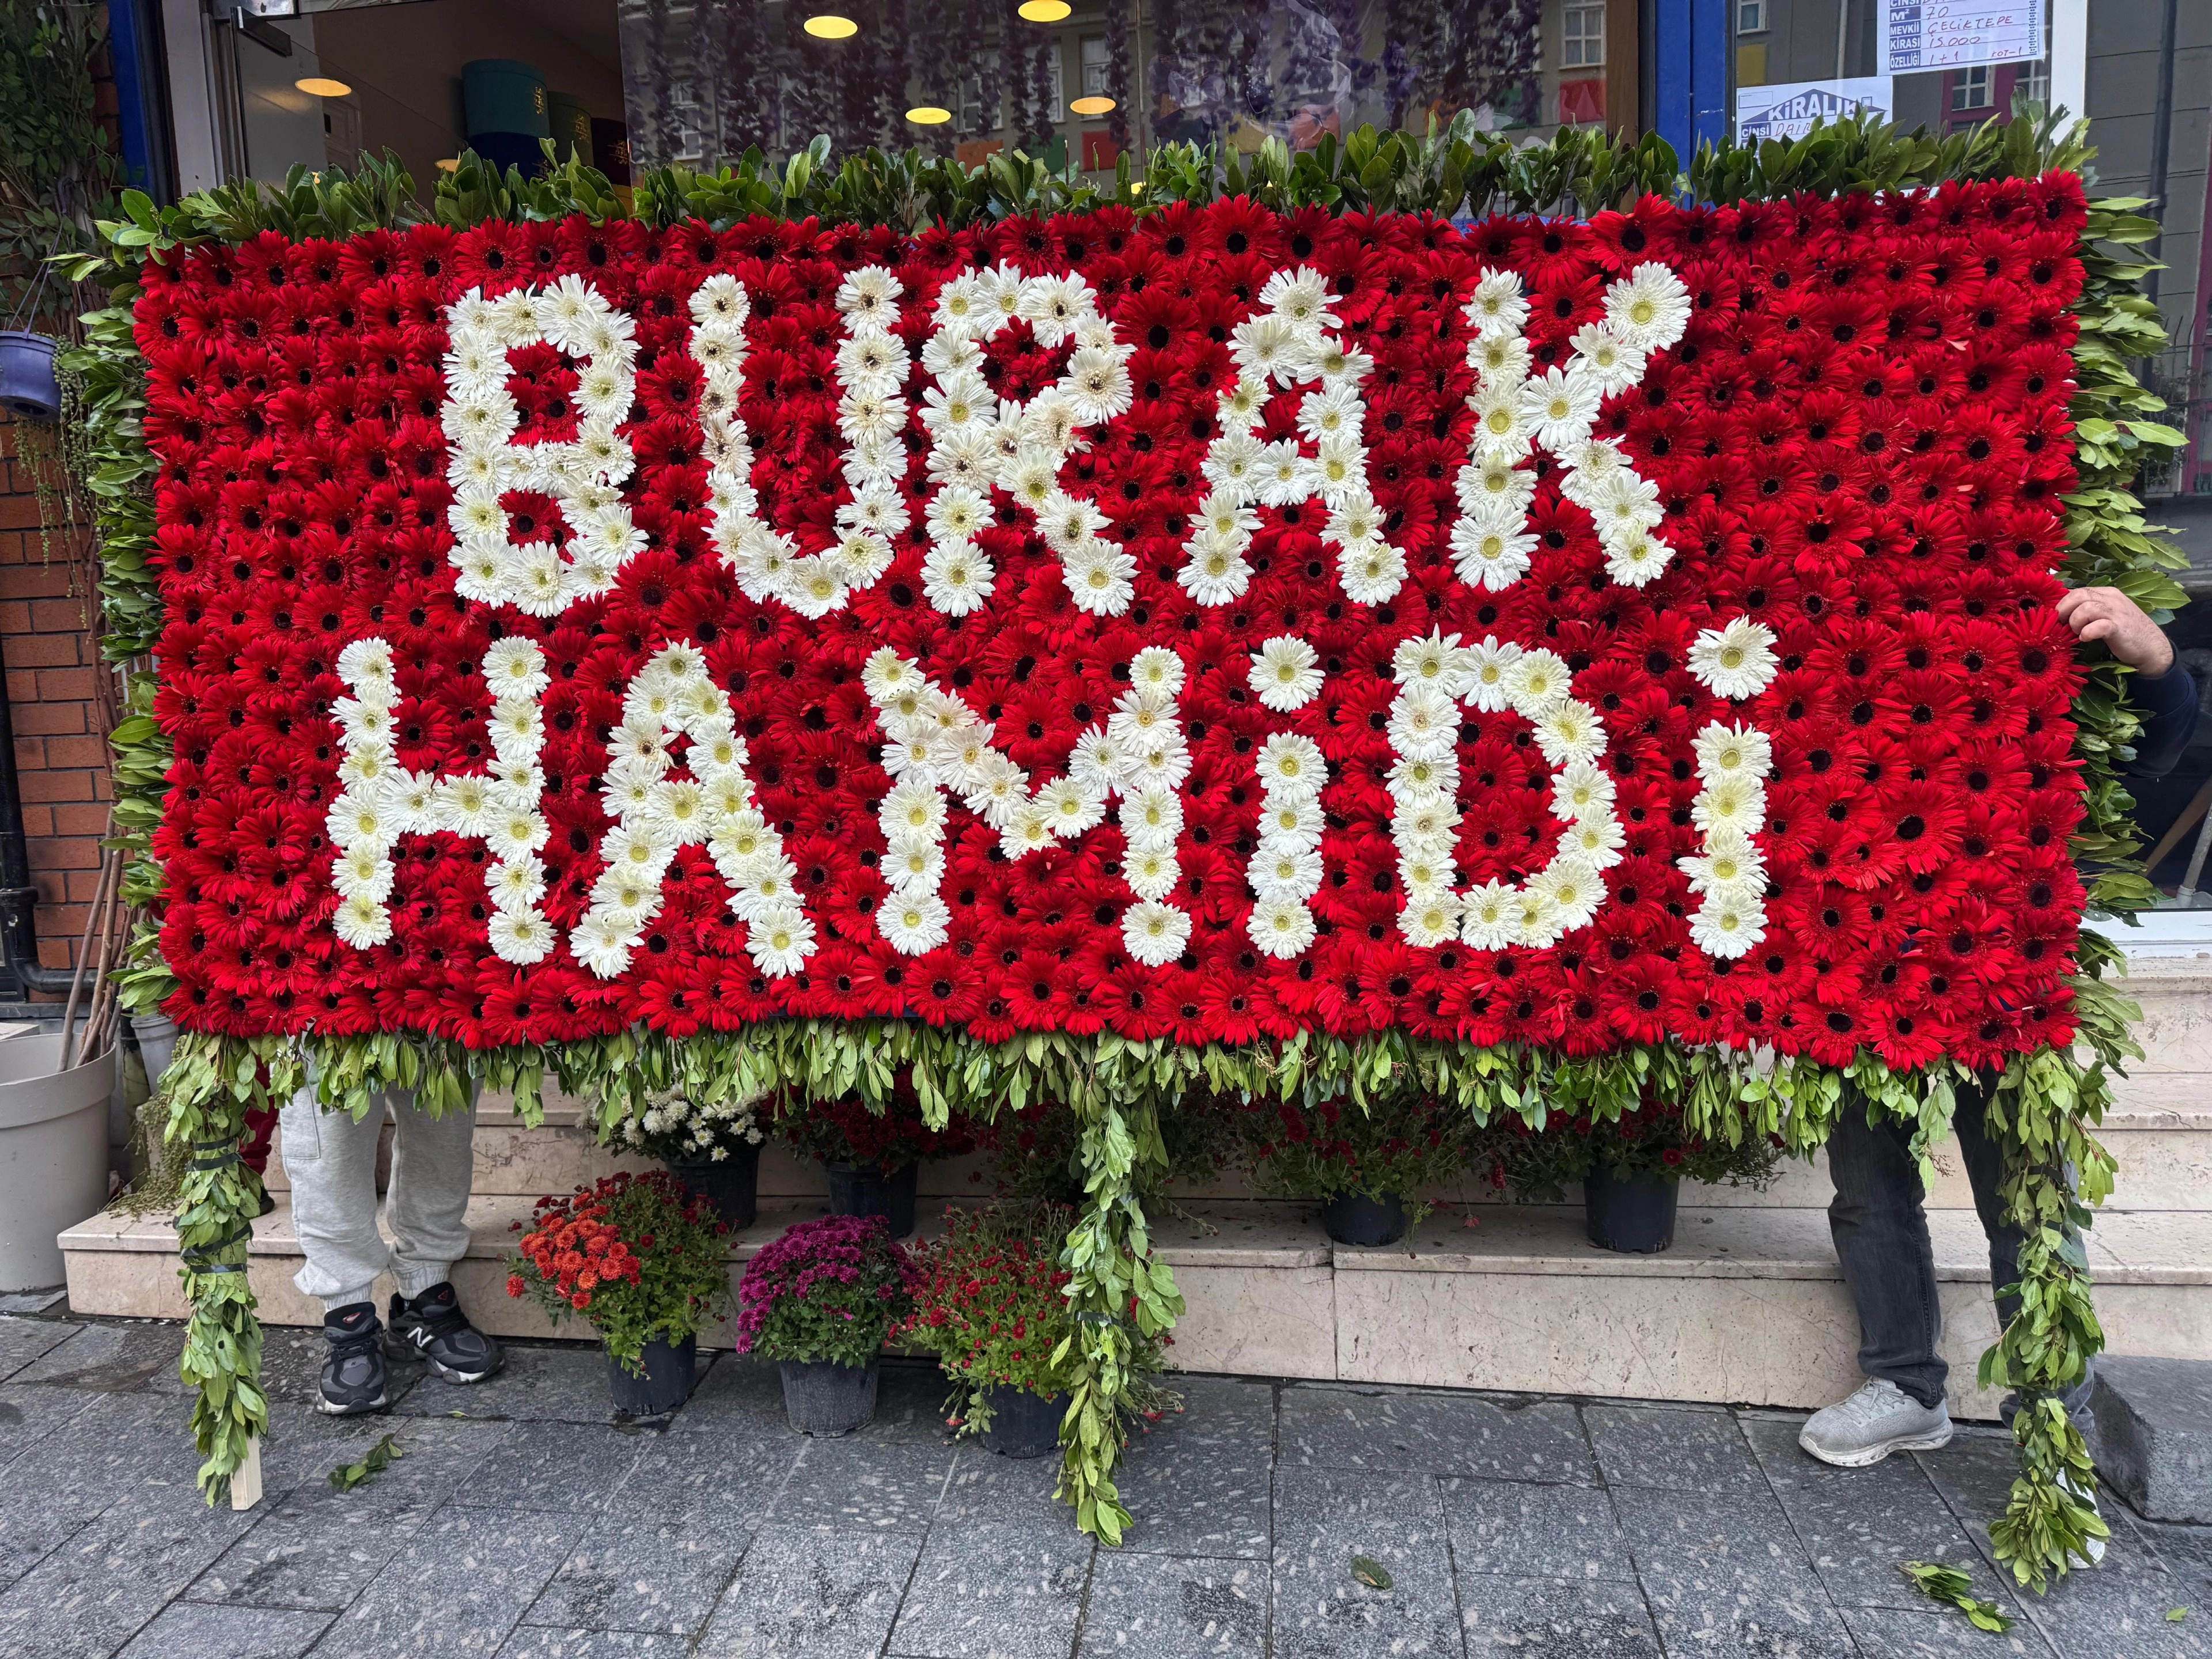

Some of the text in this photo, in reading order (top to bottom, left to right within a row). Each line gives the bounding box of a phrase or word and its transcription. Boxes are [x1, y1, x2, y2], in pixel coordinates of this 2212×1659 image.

[1926, 6, 1949, 20] 70
[1929, 36, 1980, 48] 15.000
[440, 259, 1691, 619] BURAK
